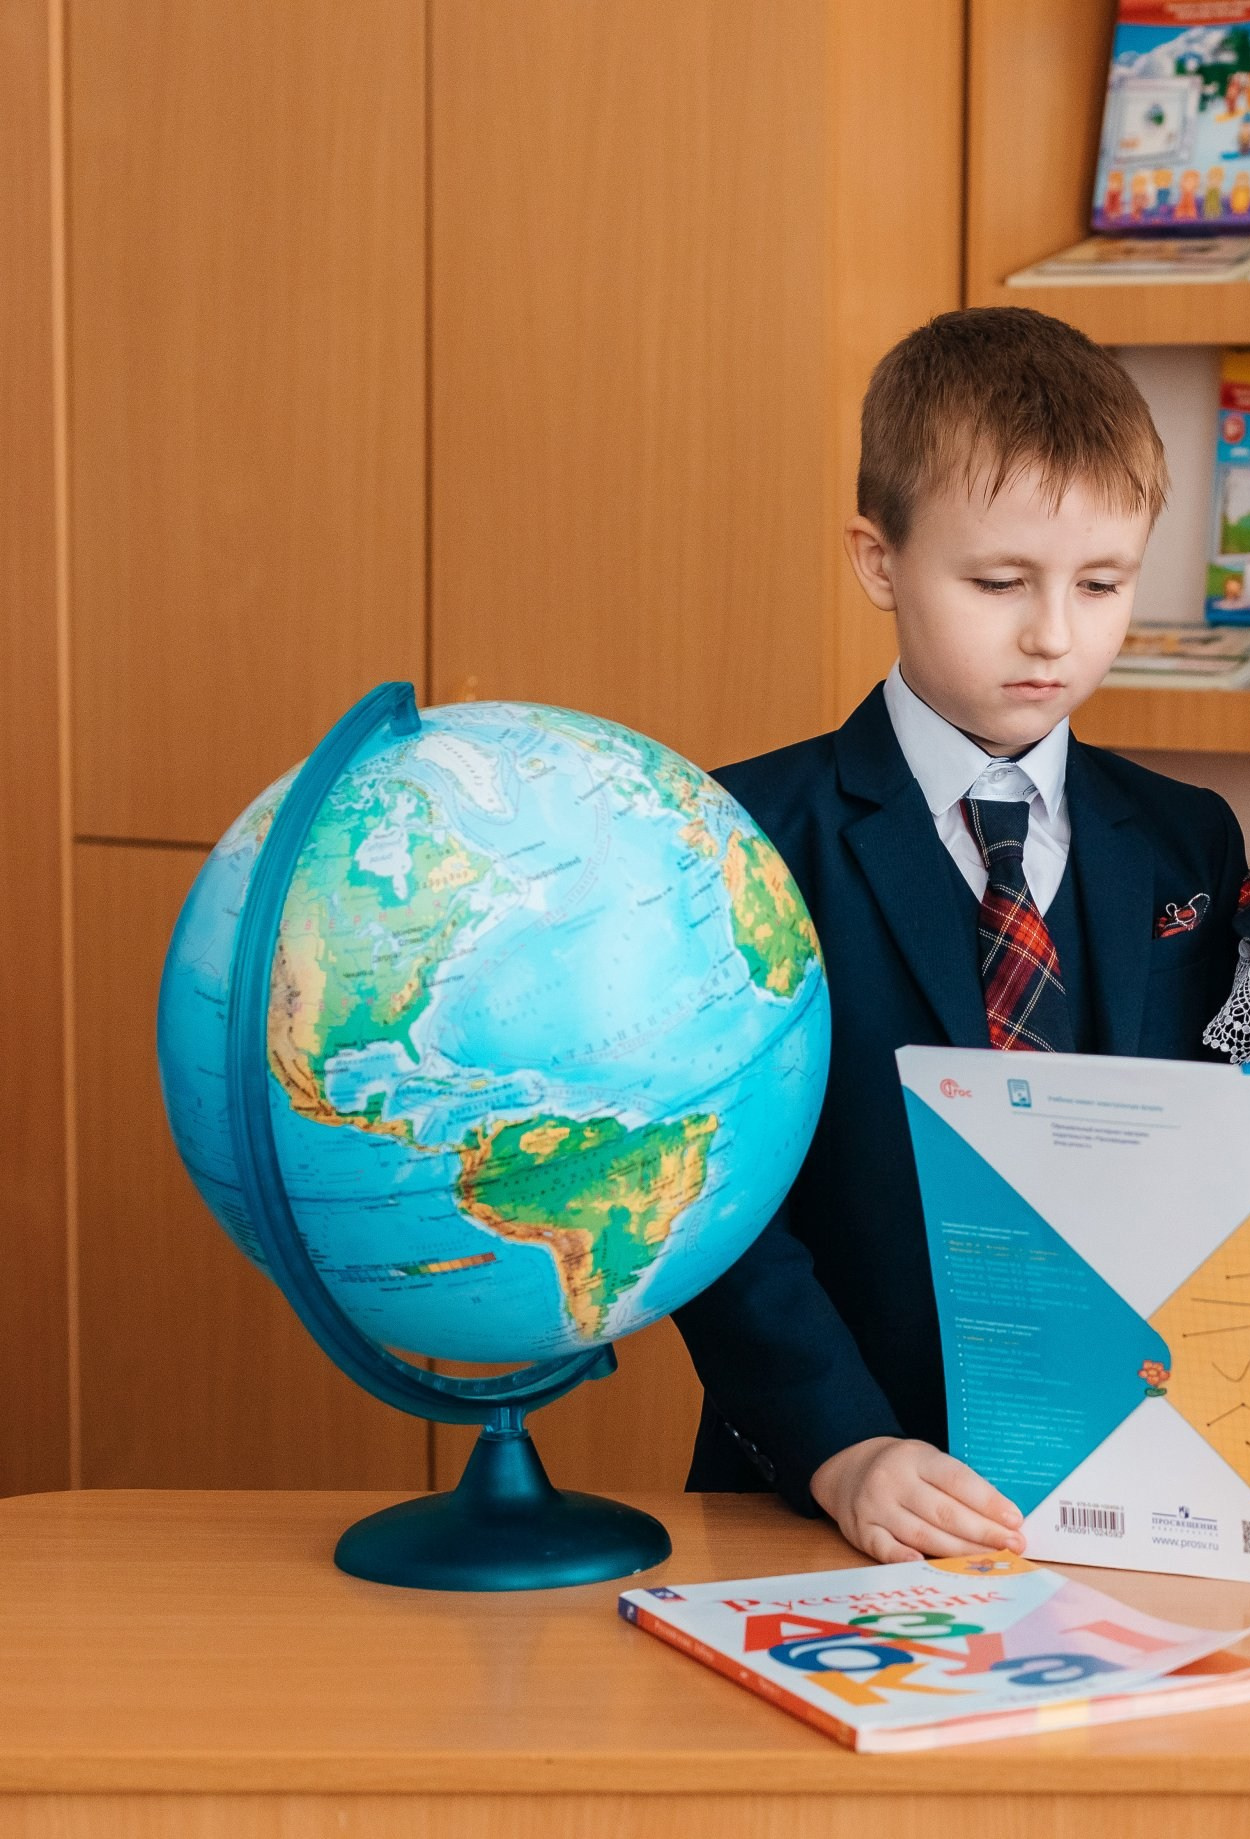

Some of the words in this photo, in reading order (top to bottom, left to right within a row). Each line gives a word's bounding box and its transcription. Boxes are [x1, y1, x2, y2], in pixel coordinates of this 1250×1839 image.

[1152, 1517, 1218, 1531] ПРОСВЕЩЕНИЕ
[1152, 1537, 1220, 1551] www.prosv.ru
[720, 1584, 942, 1612] Русский
